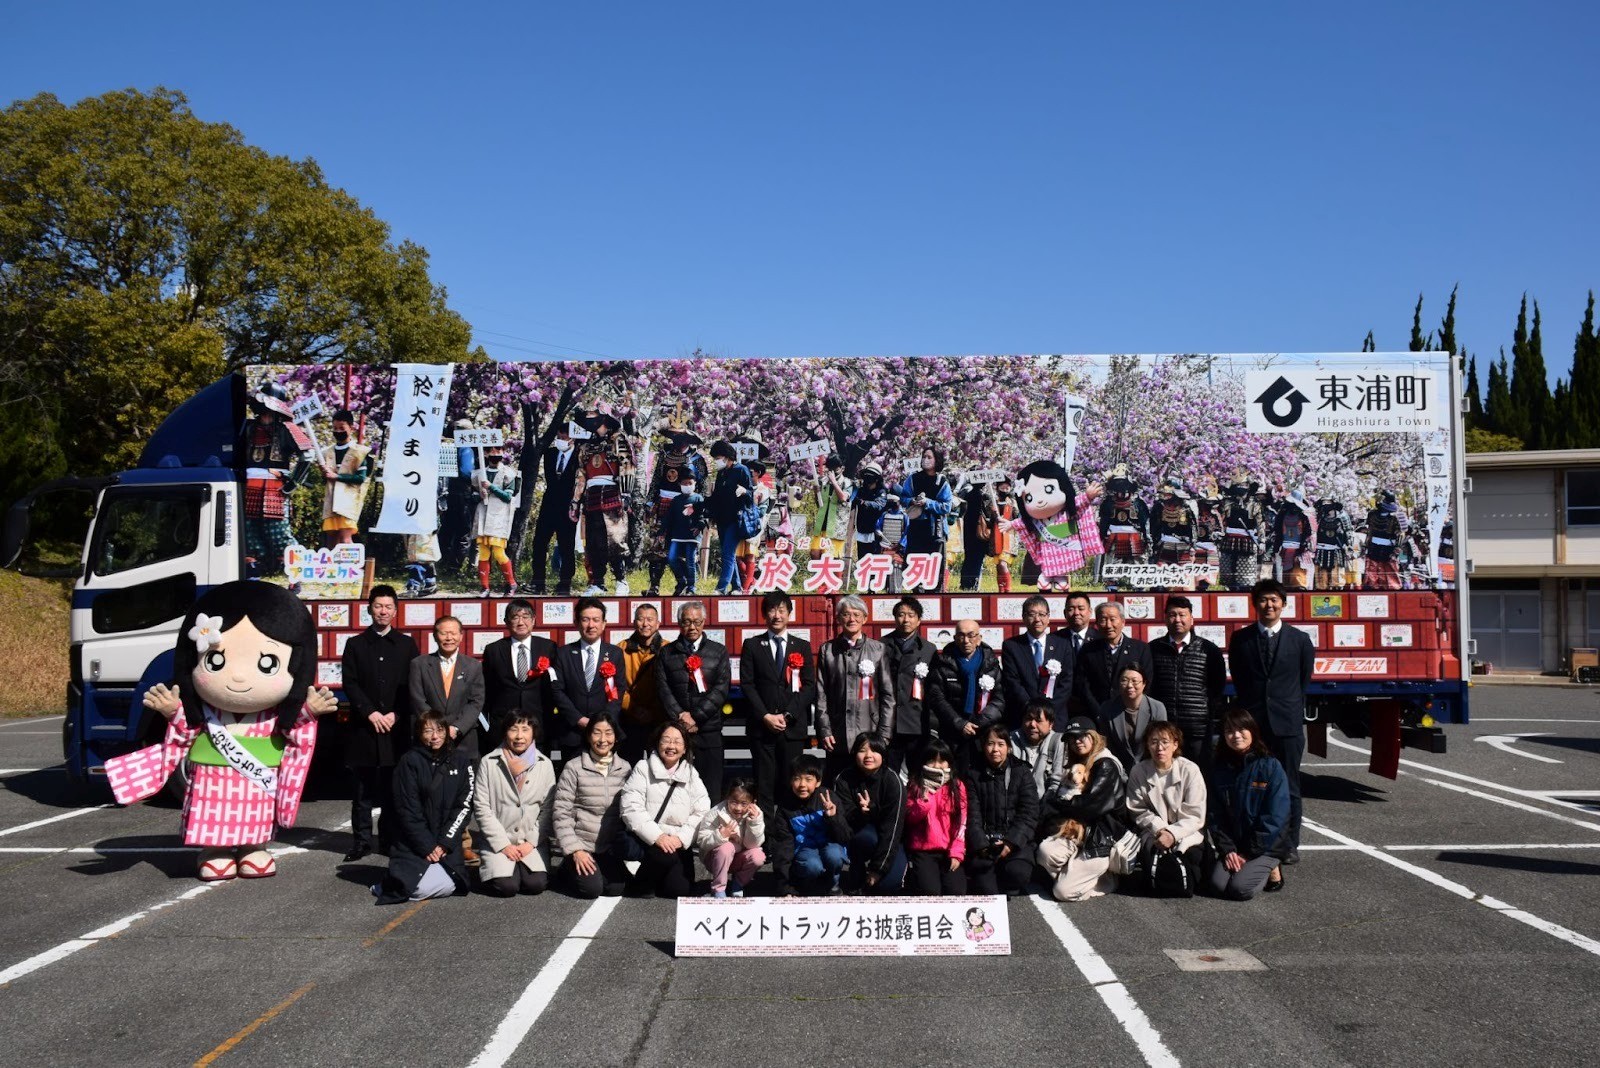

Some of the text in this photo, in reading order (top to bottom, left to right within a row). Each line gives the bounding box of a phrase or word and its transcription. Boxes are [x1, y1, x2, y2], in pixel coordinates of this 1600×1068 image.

[431, 377, 446, 416] 東浦町
[1315, 374, 1431, 411] 東浦町
[1317, 416, 1431, 428] Higashiura Town
[402, 375, 434, 517] 於大まつり
[793, 444, 827, 458] 竹千代
[776, 537, 832, 549] おだい
[289, 549, 332, 565] ドリーム
[289, 566, 358, 579] プロジェクト
[757, 555, 939, 590] 於大行列
[1104, 565, 1218, 575] 東浦町マスコットキャラクター
[446, 807, 470, 838] UNDER
[694, 912, 954, 941] ペイントトラックお披露目会
